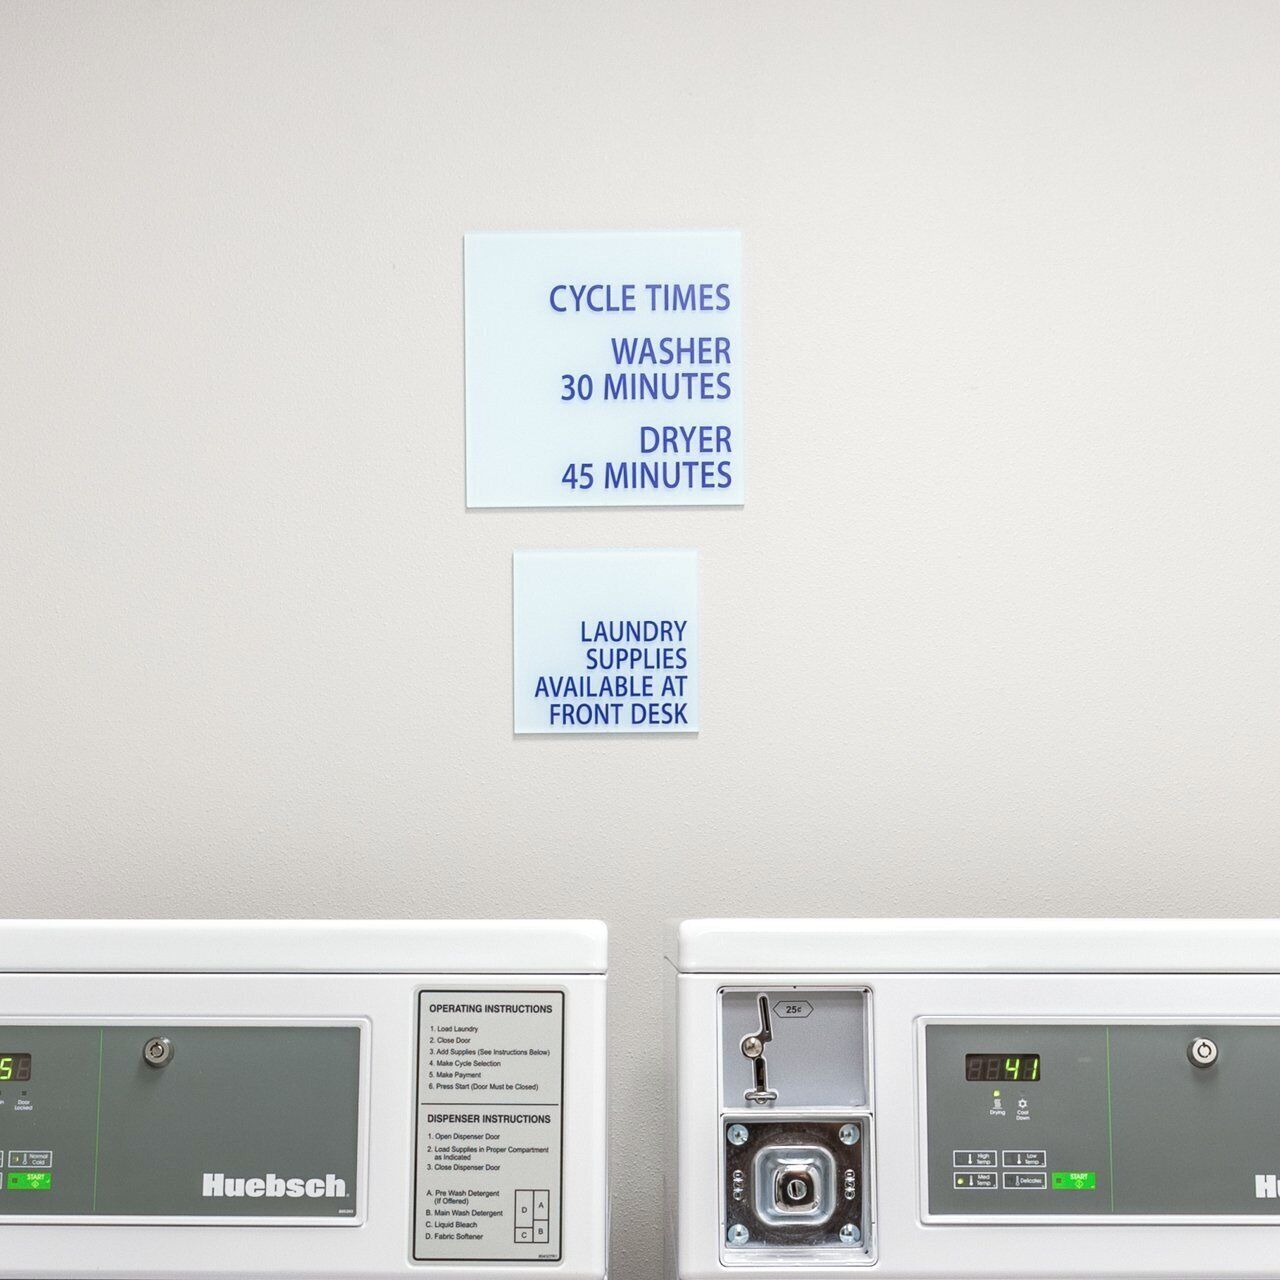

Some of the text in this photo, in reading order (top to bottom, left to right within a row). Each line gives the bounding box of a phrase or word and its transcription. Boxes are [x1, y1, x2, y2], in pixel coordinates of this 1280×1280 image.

[549, 284, 731, 312] CYCLE TIMES
[611, 337, 731, 365] WASHER
[560, 372, 731, 401] 30 MINUTES
[640, 426, 732, 453] DRYER
[561, 462, 732, 490] 45 MINUTES
[581, 620, 687, 642] LAUNDRY
[586, 648, 687, 669] SUPPLIES
[534, 676, 687, 697] AVAILABLE AT
[549, 703, 688, 725] FRONT DESK
[429, 1004, 552, 1013] OPERATING INSTRUCTIONS
[1006, 1058, 1038, 1080] 41
[428, 1114, 551, 1123] DISPENSER INSTRUCTIONS
[203, 1173, 346, 1197] Huebsch
